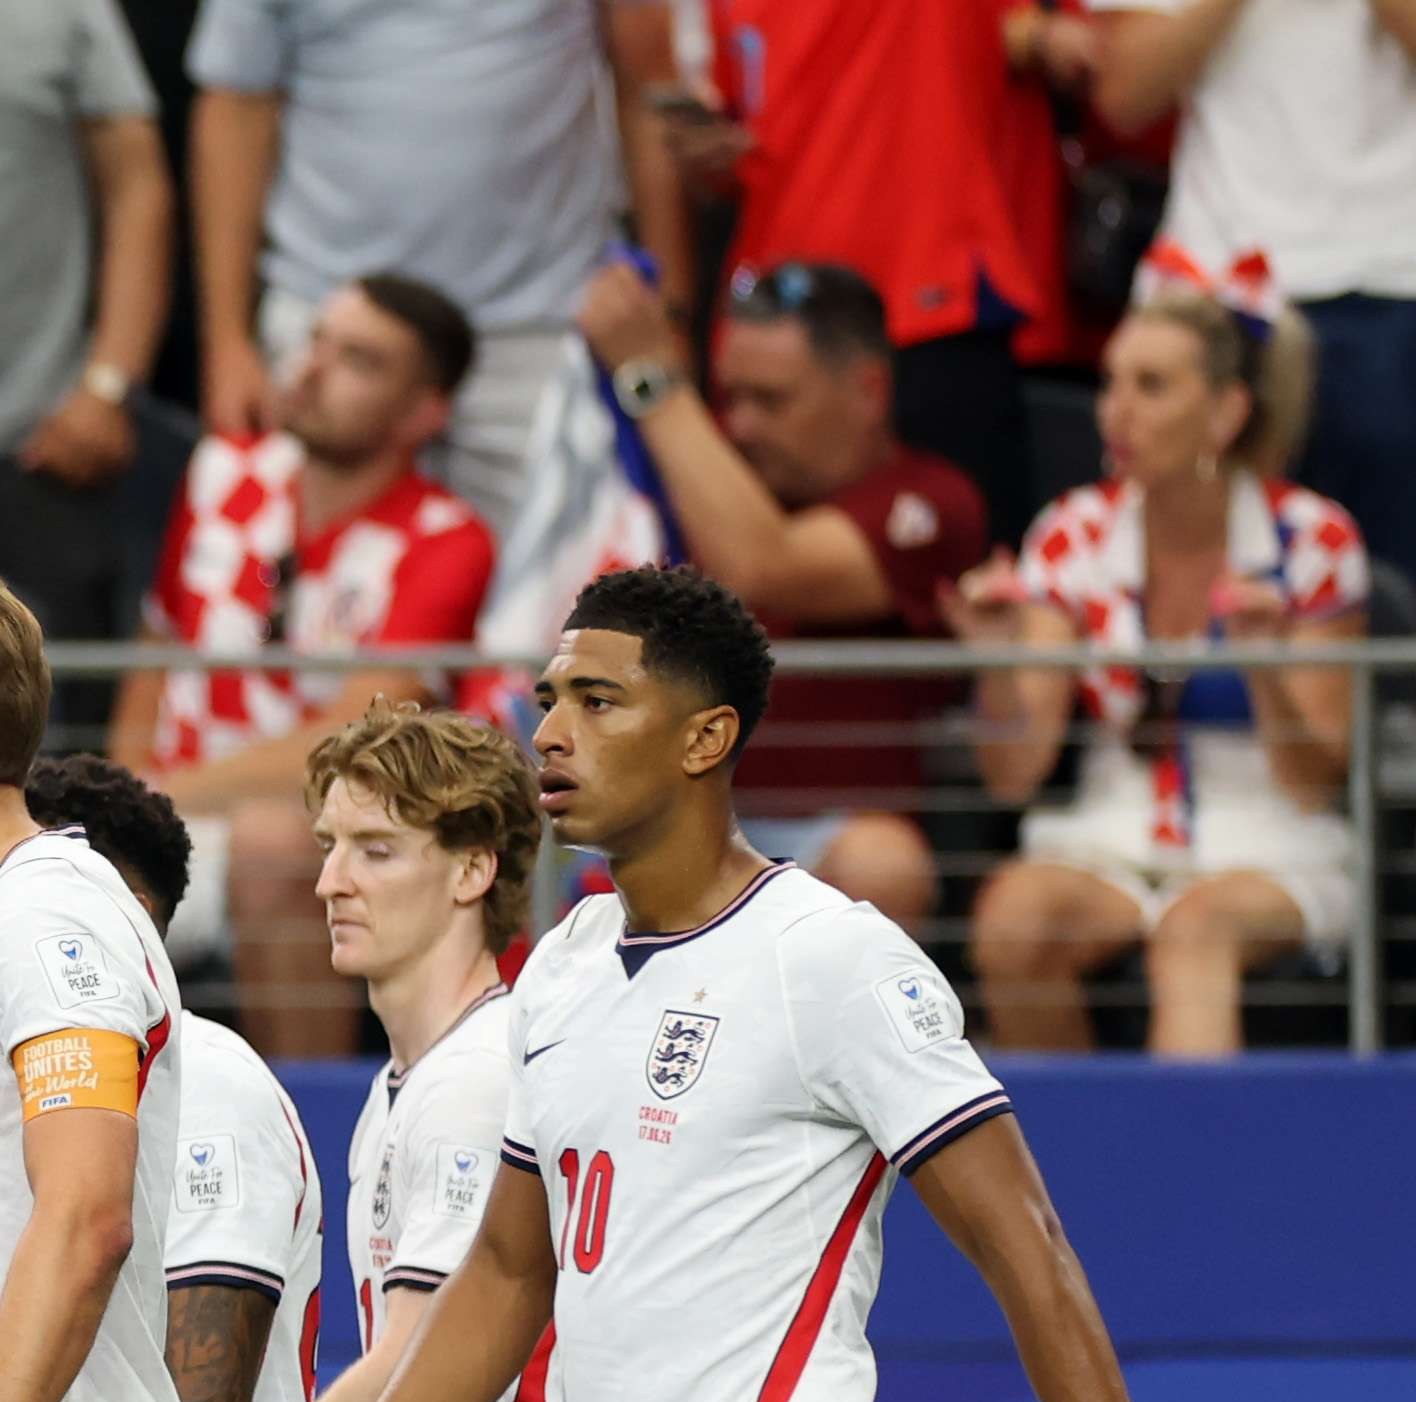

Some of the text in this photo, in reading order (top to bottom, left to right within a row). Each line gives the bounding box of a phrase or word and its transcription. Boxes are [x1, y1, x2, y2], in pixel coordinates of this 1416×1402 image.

[68, 973, 101, 990] PEACE
[913, 1011, 944, 1032] PEACE
[24, 1036, 92, 1064] FOOTBALL
[24, 1051, 94, 1083] UNITES
[44, 1070, 99, 1093] World
[42, 1096, 68, 1108] FIFA
[639, 1106, 678, 1125] CROATIA
[190, 1181, 222, 1197] PEACE
[558, 1147, 615, 1275] 10
